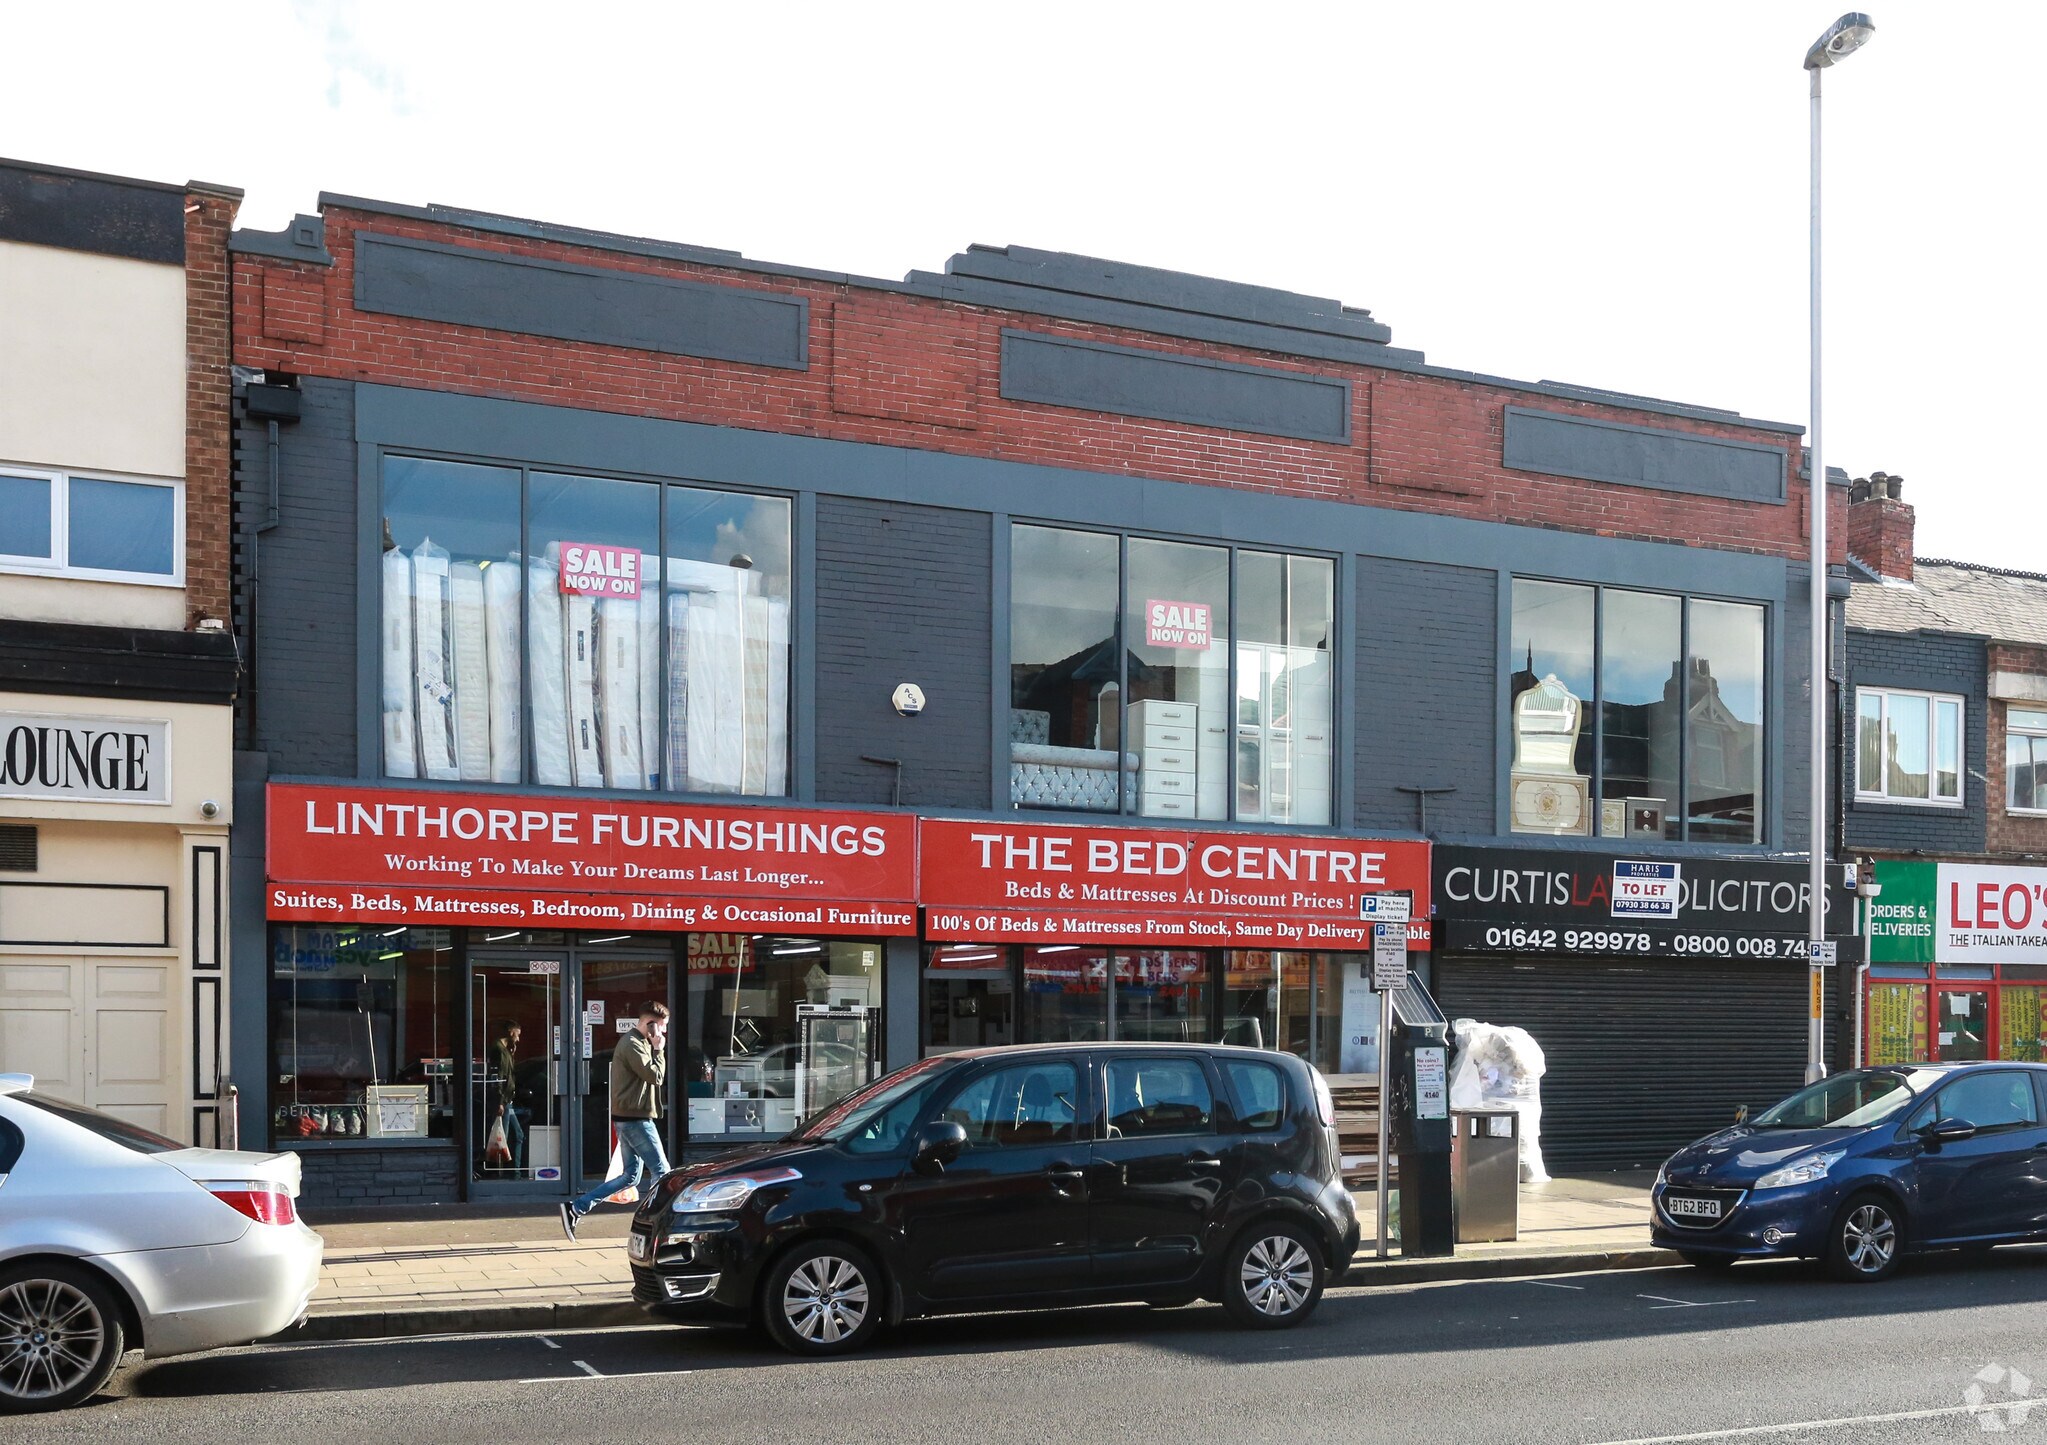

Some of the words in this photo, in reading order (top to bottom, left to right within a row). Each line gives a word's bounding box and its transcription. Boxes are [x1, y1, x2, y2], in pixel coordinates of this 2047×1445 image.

[566, 548, 635, 578] SALE
[565, 574, 607, 591] NOW
[611, 580, 635, 594] ON
[1151, 604, 1207, 631] SALE
[1151, 628, 1184, 643] NOW
[1187, 631, 1207, 645] ON
[0, 725, 150, 792] OUNGE
[305, 800, 579, 845] LINTHORPE
[591, 813, 887, 857] FURNISHINGS
[384, 853, 473, 878] Working
[478, 857, 506, 874] To
[511, 858, 564, 876] Make
[570, 860, 618, 878] Your
[623, 863, 695, 881] Dreams
[700, 865, 739, 882] Last
[744, 867, 824, 889] Longer...
[971, 833, 1073, 872] THE
[1087, 839, 1188, 876] BED
[1201, 845, 1386, 885] CENTRE
[1631, 864, 1660, 873] HARIS
[1005, 881, 1051, 899] Beds
[1057, 883, 1074, 900] &
[1081, 884, 1177, 903] Mattresses
[1183, 887, 1204, 904] At
[1209, 888, 1287, 908] Discount
[1291, 892, 1344, 909] Prices
[1622, 883, 1640, 895] TO
[1644, 884, 1667, 896] LET
[273, 890, 344, 912] Suites,
[350, 893, 408, 915] Beds,
[414, 895, 526, 918] Mattresses,
[531, 899, 626, 921] Bedroom,
[631, 902, 696, 925] Dining
[701, 904, 718, 920] &
[723, 904, 823, 923] Occasional
[827, 908, 911, 925] Furniture
[1616, 901, 1639, 909] 07930
[1650, 902, 1660, 910] 66
[1660, 902, 1670, 910] 38
[1870, 904, 1915, 918] ORDERS
[1918, 905, 1928, 918] &
[1951, 882, 2047, 930] LEO'
[932, 915, 971, 931] 100's
[975, 915, 997, 931] Of
[1001, 917, 1039, 932] Beds
[1043, 918, 1058, 933] &
[1062, 918, 1141, 934] Mattresses
[1146, 920, 1185, 935] From
[1189, 920, 1232, 938] Stock,
[1235, 921, 1273, 937] Same
[1276, 923, 1303, 941] Day
[1307, 923, 1365, 943] Delivery
[1485, 927, 1557, 948] 01642
[1564, 931, 1651, 952] 929978
[1673, 934, 1730, 955] 0800
[1735, 937, 1776, 956] 008
[1782, 939, 1810, 957] 74
[1864, 922, 1932, 937] ELIVERIES
[1949, 934, 1969, 946] THE
[1972, 935, 2014, 947] ITALIAN
[2016, 936, 2047, 947] TAKEA
[688, 932, 750, 955] SALE
[687, 956, 723, 969] NOW
[727, 956, 750, 968] ON
[1914, 1033, 1928, 1062] LE
[1672, 1199, 1696, 1213] BT62
[1697, 1201, 1717, 1214] BFO
